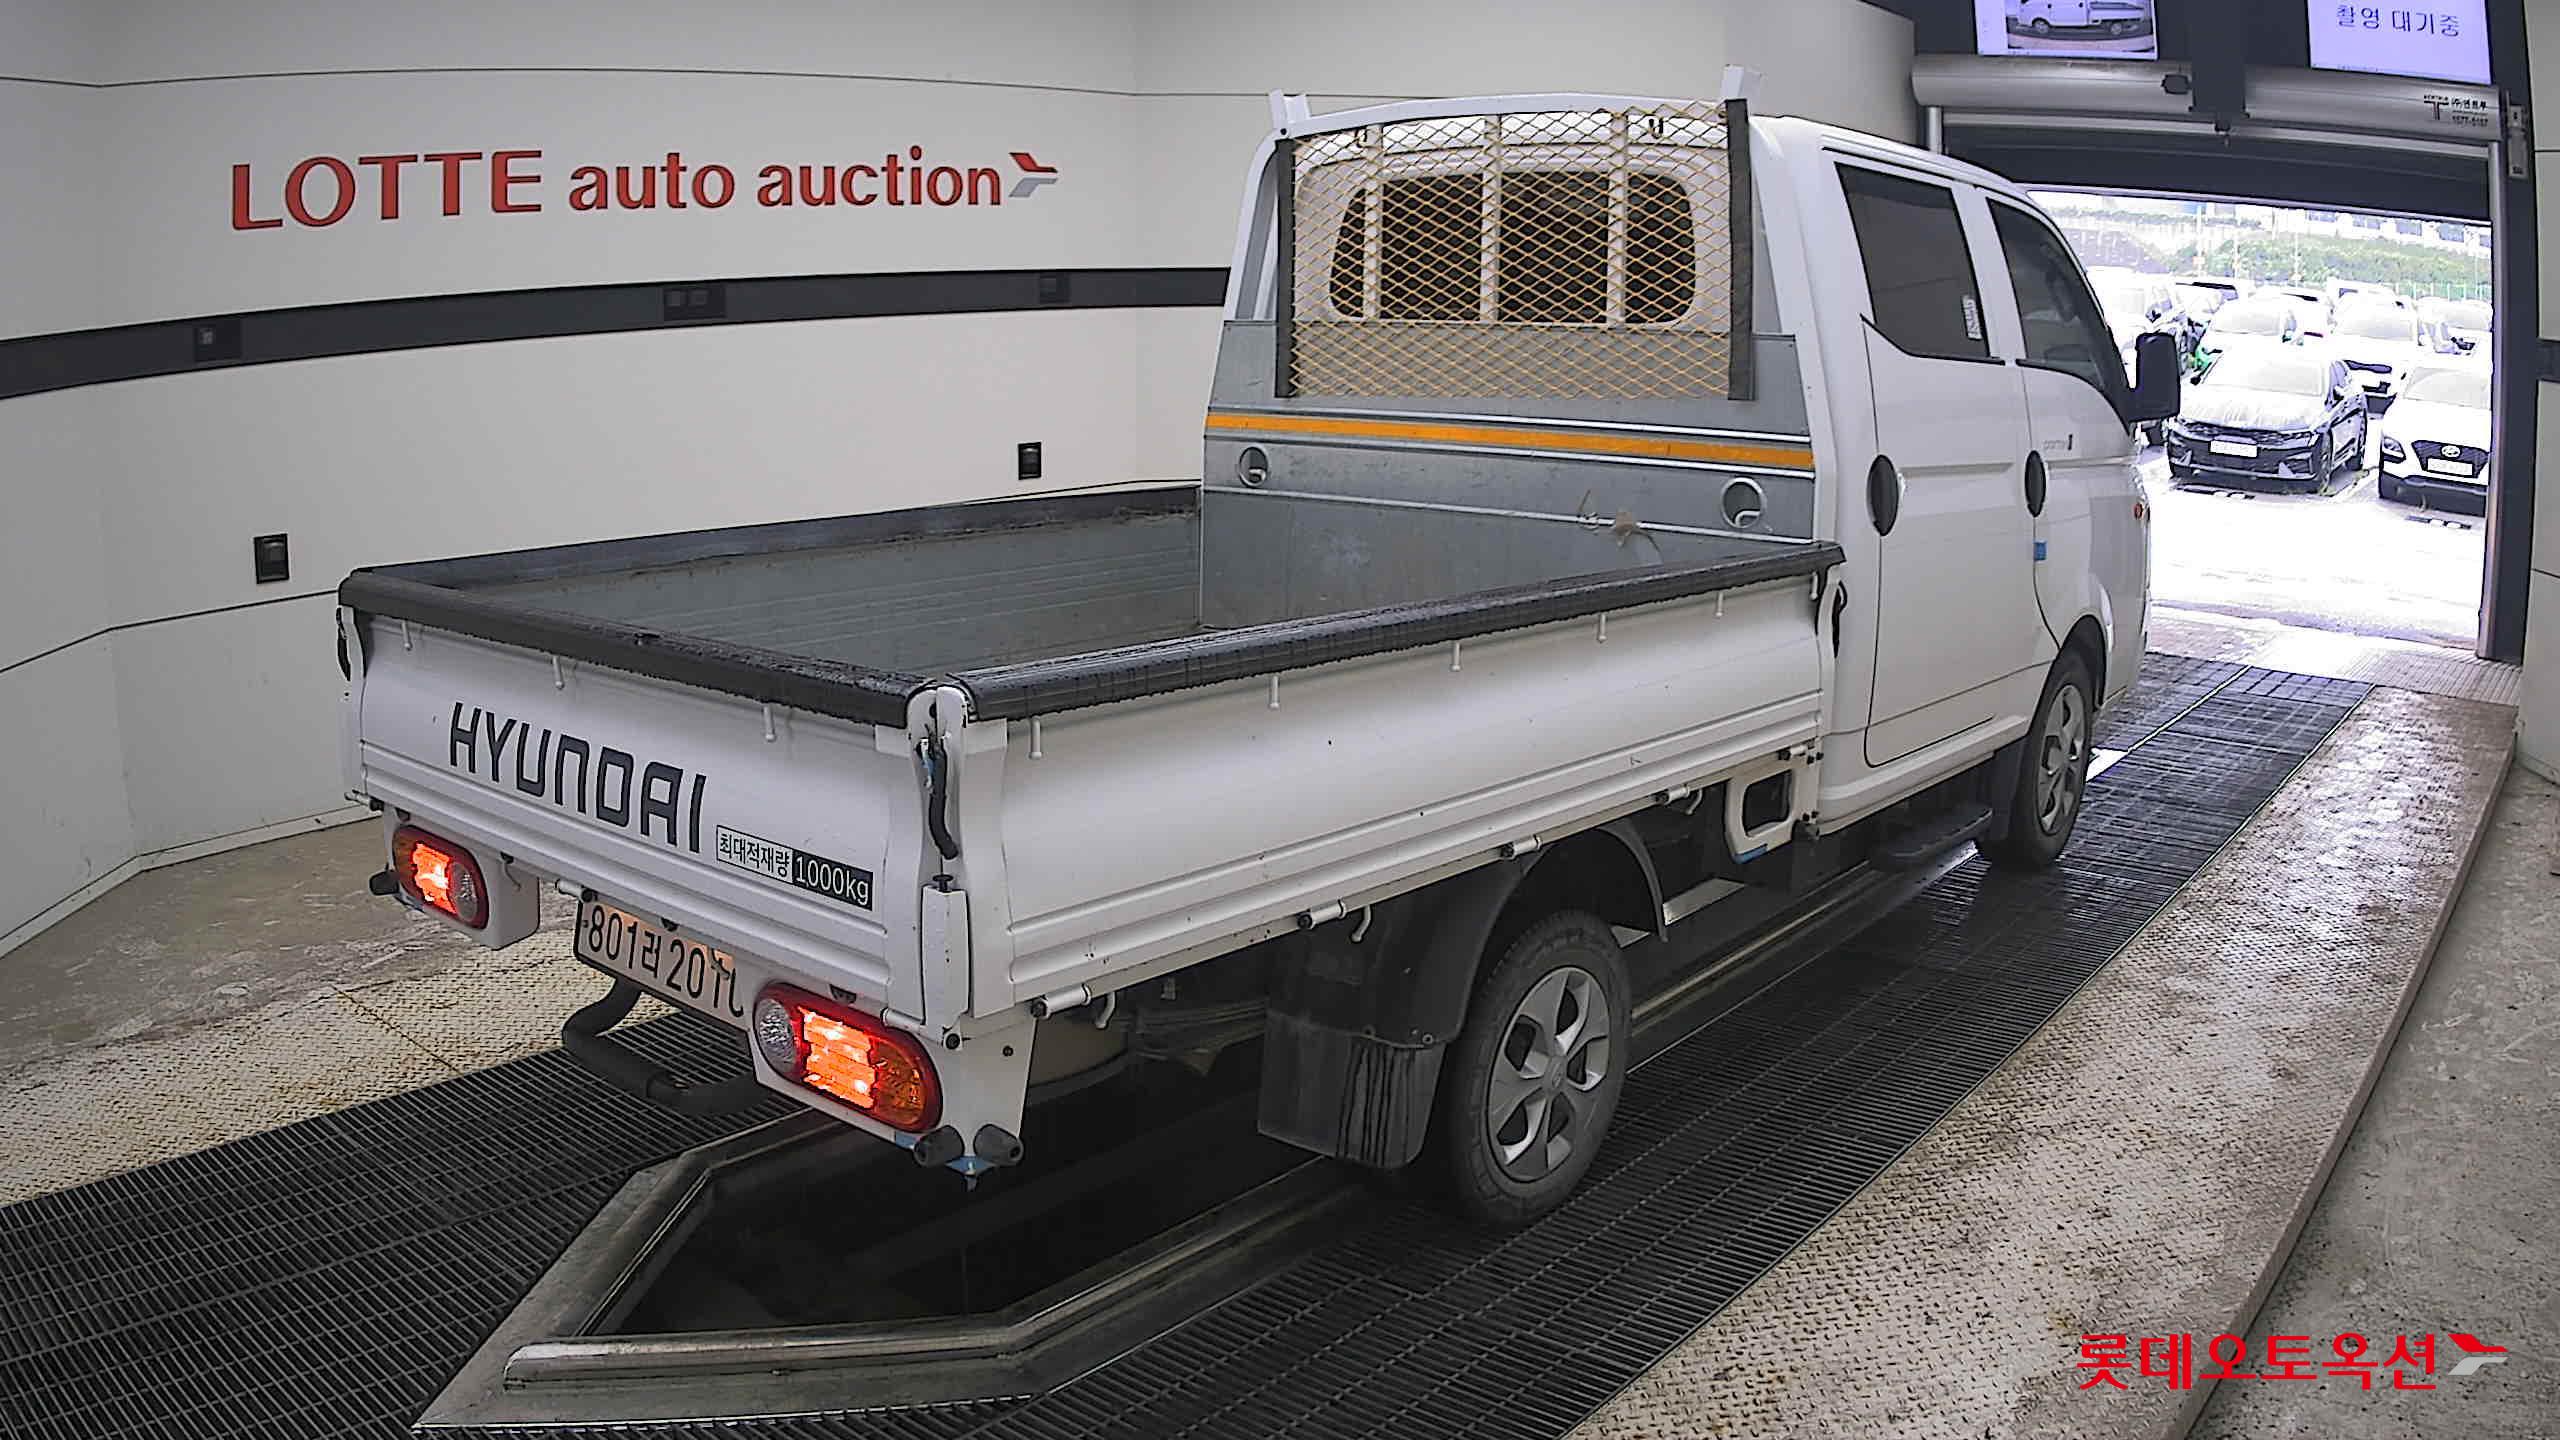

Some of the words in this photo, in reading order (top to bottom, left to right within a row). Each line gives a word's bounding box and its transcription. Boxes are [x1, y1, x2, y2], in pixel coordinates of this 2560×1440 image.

[2338, 5, 2380, 29] 촬영
[2392, 11, 2459, 37] 대기중
[231, 150, 542, 231] LOTTE
[568, 152, 735, 209] auto
[756, 146, 1002, 208] auction
[449, 702, 707, 853] HYUNDAI
[719, 833, 791, 879] 최대적재량
[795, 855, 870, 907] 1000kg
